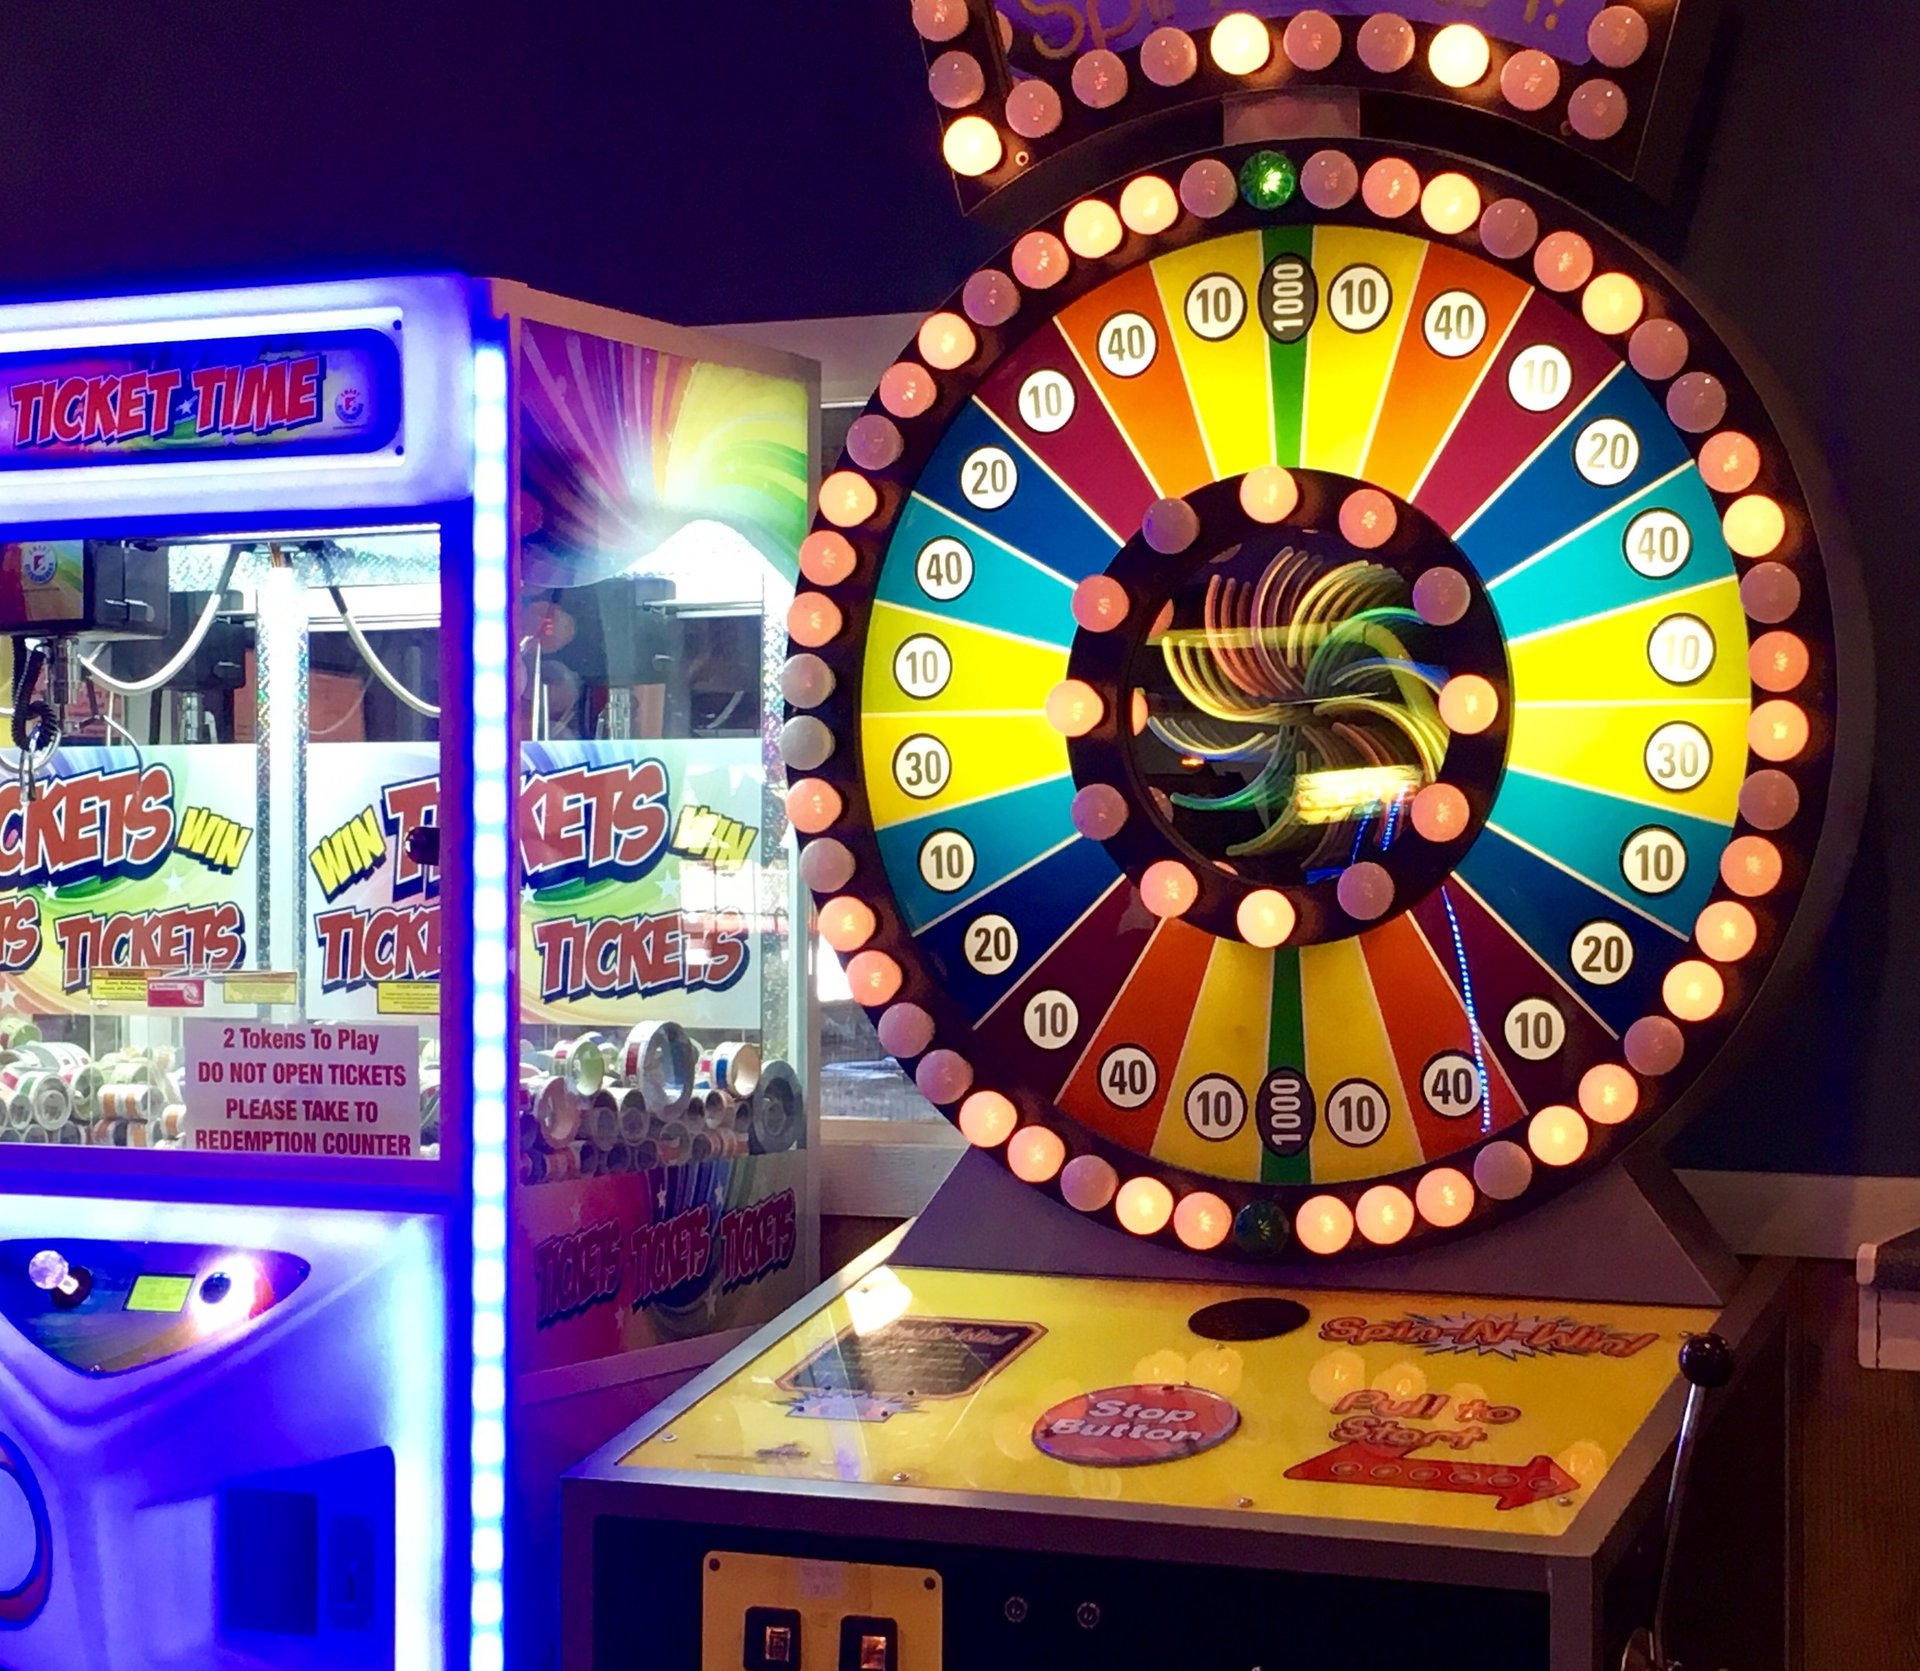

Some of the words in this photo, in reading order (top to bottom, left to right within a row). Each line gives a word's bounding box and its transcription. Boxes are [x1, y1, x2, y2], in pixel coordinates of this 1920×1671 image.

[1196, 286, 1231, 324] 10
[1273, 261, 1304, 332] 1000
[1340, 278, 1377, 315] 10
[1434, 304, 1475, 341] 40
[1107, 323, 1145, 361] 40
[1523, 359, 1558, 396] 10
[11, 369, 182, 447] TICKET
[192, 354, 325, 434] TIME
[1028, 382, 1063, 418] 10
[1588, 433, 1629, 470] 20
[971, 459, 1007, 495] 20
[1637, 526, 1678, 563] 40
[926, 552, 963, 586] 40
[905, 650, 938, 685] 10
[1664, 634, 1700, 671] 10
[905, 751, 942, 786] 30
[1656, 742, 1699, 780] 30
[178, 806, 253, 872] WIN
[309, 805, 387, 900] WIN
[671, 805, 758, 872] WIN
[930, 844, 965, 880] 10
[1634, 844, 1674, 882] 10
[55, 903, 246, 990] TICKETS
[532, 908, 750, 1002] TICKETS
[974, 927, 1012, 962] 20
[1580, 935, 1624, 973] 20
[1033, 1001, 1068, 1038] 10
[1515, 1011, 1553, 1049] 10
[223, 1027, 235, 1048] 2
[240, 1028, 306, 1049] Tokens
[310, 1028, 332, 1050] To
[338, 1029, 380, 1055] Play
[198, 1061, 224, 1083] DO
[230, 1062, 267, 1084] NOT
[272, 1062, 323, 1085] OPEN
[328, 1063, 407, 1087] TICKETS
[1107, 1059, 1147, 1096] 40
[1431, 1067, 1473, 1105] 40
[226, 1098, 298, 1120] PLEASE
[302, 1099, 349, 1122] TAKE
[354, 1101, 379, 1123] TO
[1196, 1090, 1231, 1127] 10
[1271, 1076, 1302, 1147] 1000
[1338, 1096, 1376, 1132] 10
[195, 1129, 317, 1153] REDEMPTION
[322, 1132, 411, 1156] COUNTER
[630, 1204, 713, 1311] TICKETS
[720, 1188, 796, 1294] TICKETS
[1088, 1399, 1198, 1425] Stop
[1330, 1389, 1452, 1420] Pull
[1455, 1399, 1522, 1425] to
[1050, 1418, 1203, 1443] Button
[1329, 1415, 1488, 1450] Start
